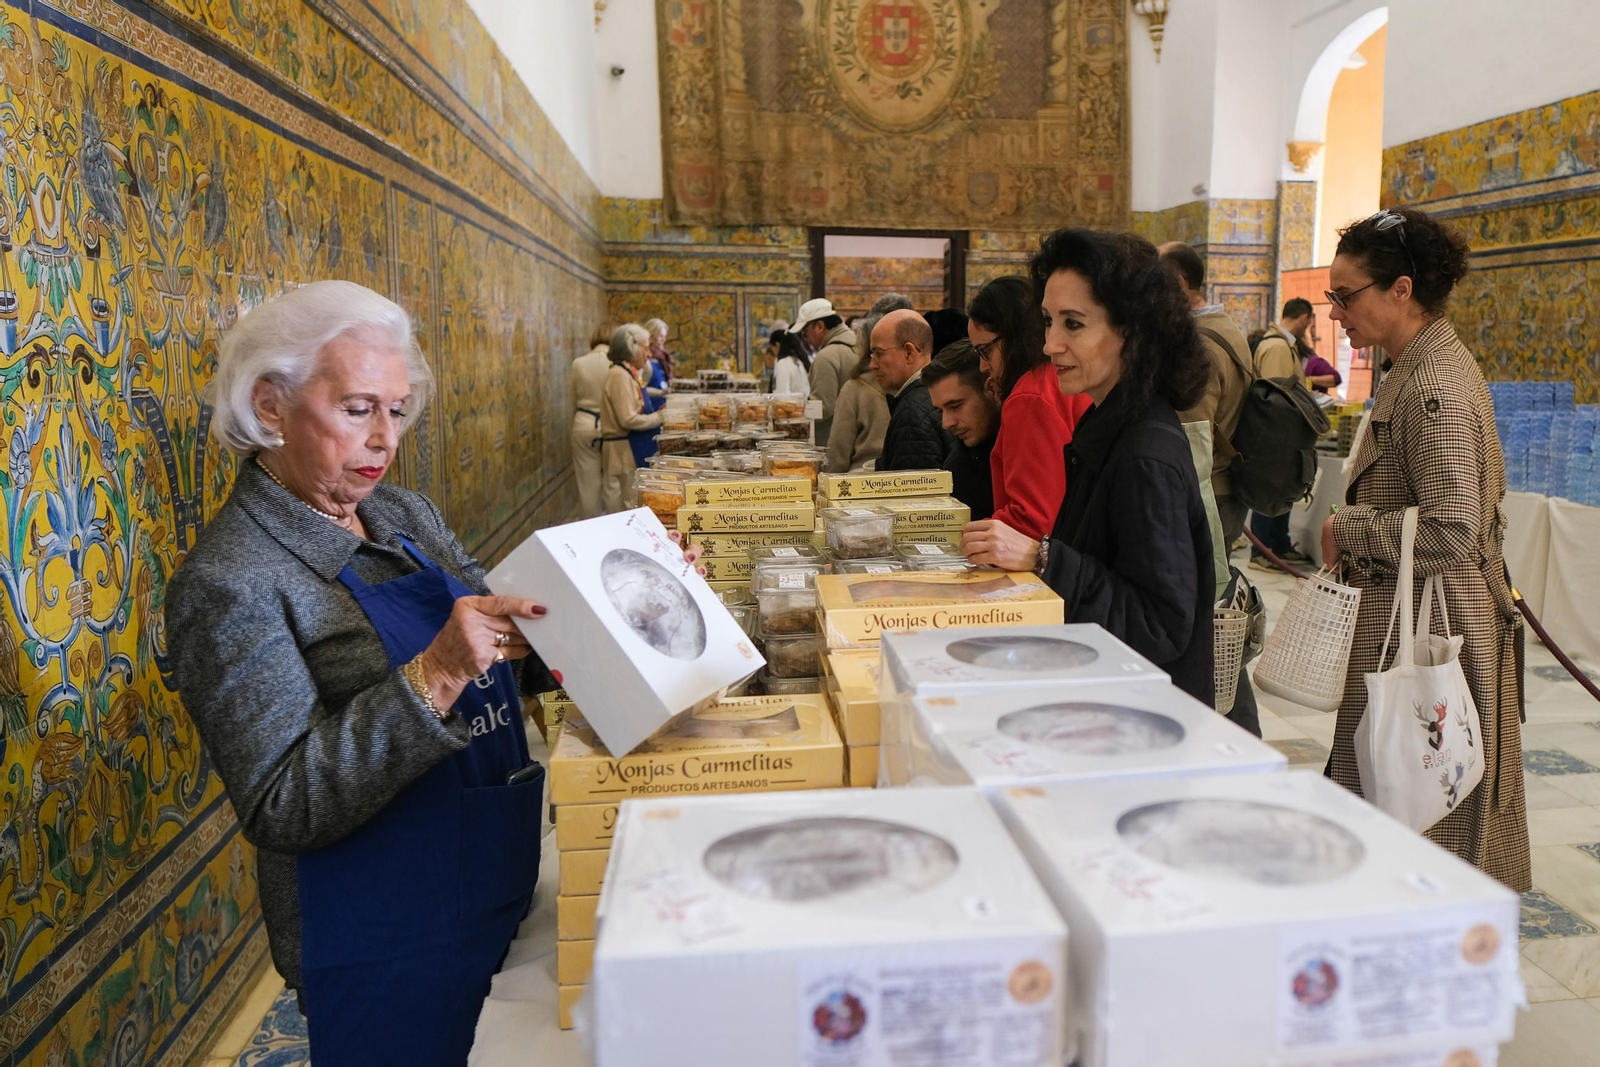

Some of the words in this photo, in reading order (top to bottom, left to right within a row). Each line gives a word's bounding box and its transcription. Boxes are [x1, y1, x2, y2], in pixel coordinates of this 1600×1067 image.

[861, 478, 892, 491] Monjas
[893, 476, 937, 487] Carmelitas
[719, 486, 751, 498] Monjas
[752, 485, 797, 495] Carmelitas
[714, 513, 748, 525] Monjas
[750, 511, 799, 522] Carmelitas
[908, 511, 955, 524] Carmelitas
[726, 537, 760, 549] Monjas
[762, 536, 811, 546] Carmelitas
[726, 561, 757, 573] Monja
[863, 613, 928, 633] Monjas
[932, 608, 1023, 629] Carmelitas
[596, 758, 675, 785] Monjas
[681, 753, 794, 778] Carmelitas
[630, 783, 700, 795] PRODUCTOS
[702, 778, 769, 791] ARTESANOS
